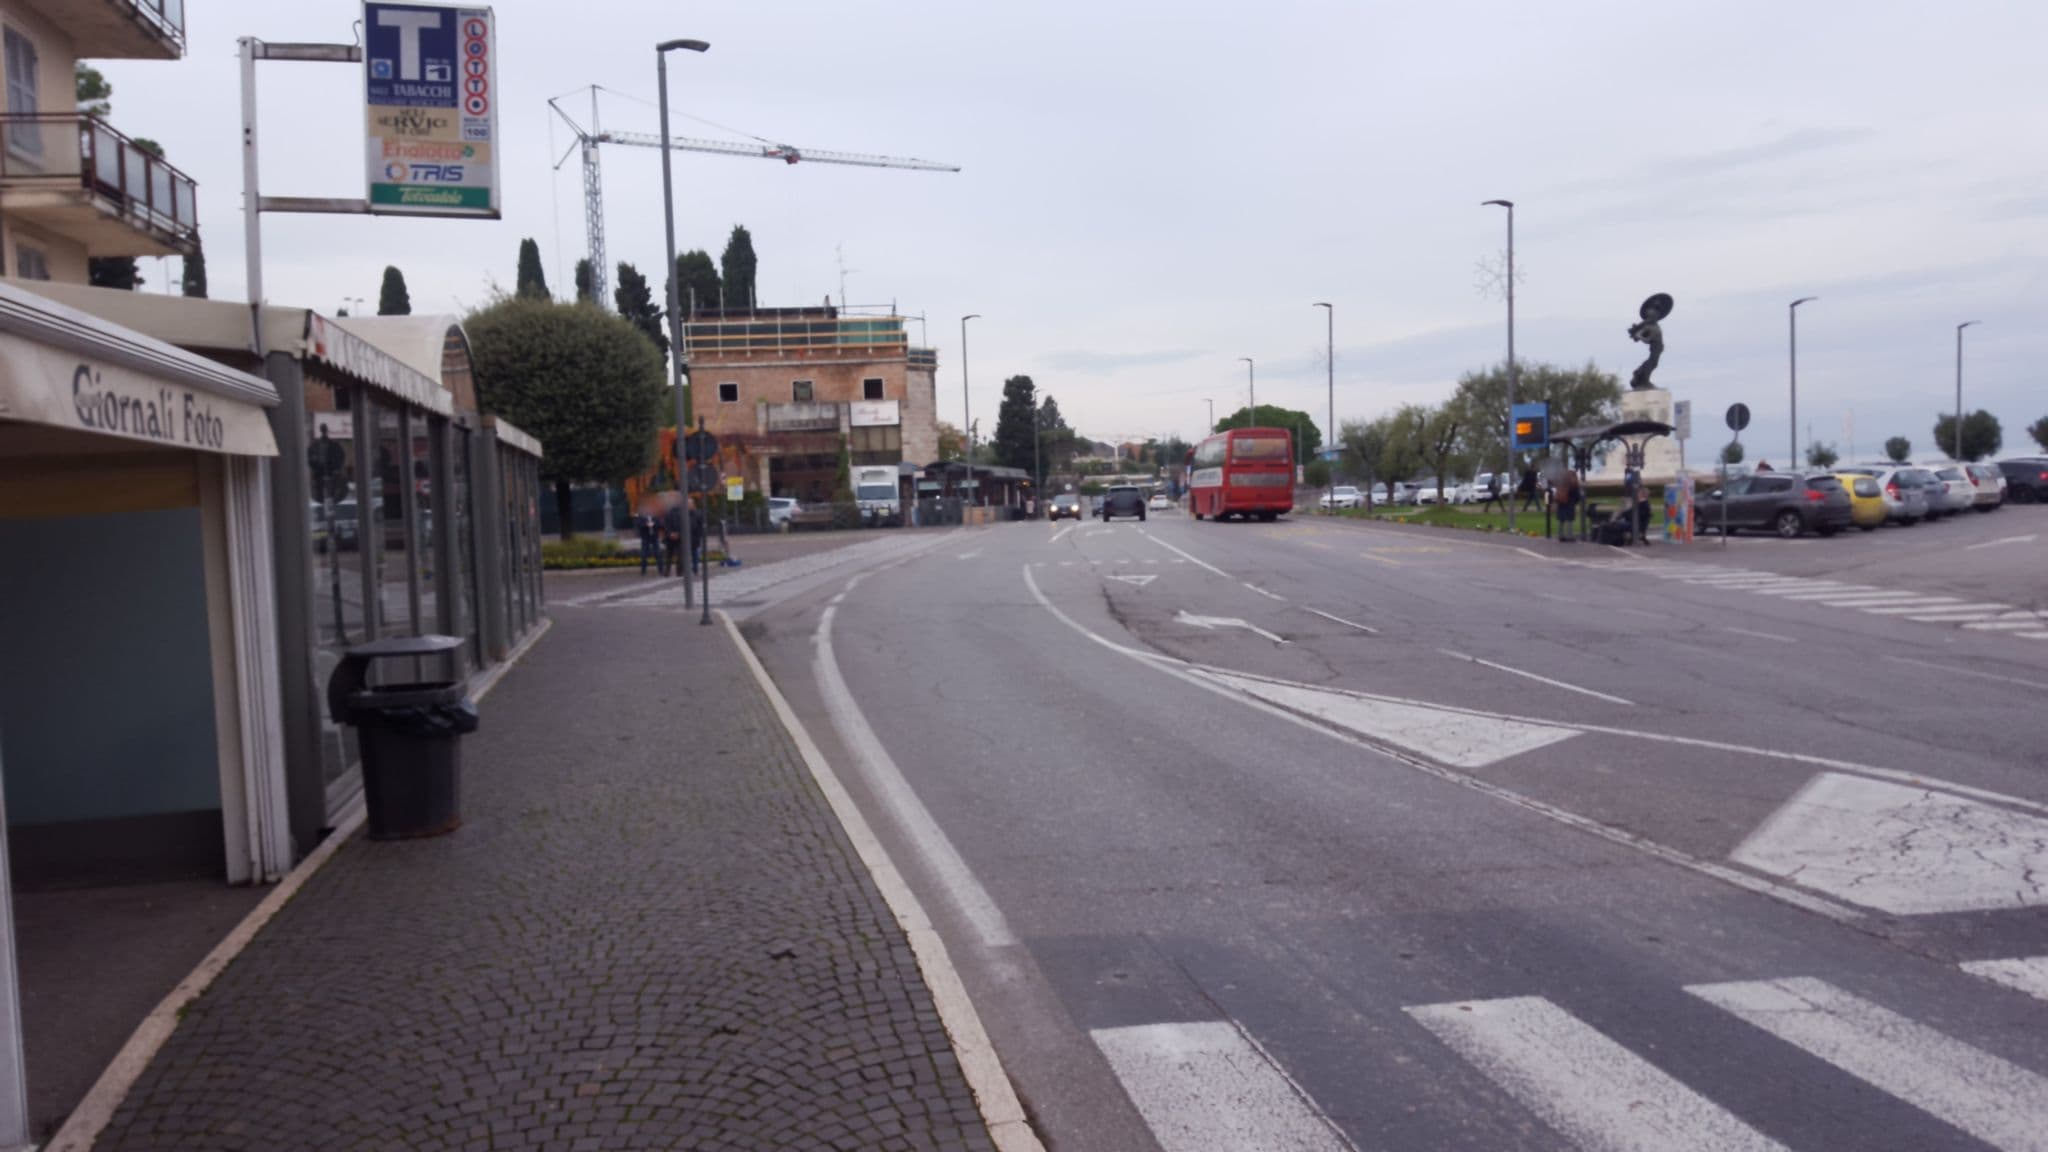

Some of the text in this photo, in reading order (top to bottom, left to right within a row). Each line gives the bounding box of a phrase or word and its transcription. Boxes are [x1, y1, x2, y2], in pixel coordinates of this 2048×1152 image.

[377, 9, 441, 80] T
[466, 19, 486, 112] LOTTO
[393, 84, 452, 98] TABACCHI
[410, 164, 464, 181] TRIS
[73, 364, 223, 449] Giornali Foto
